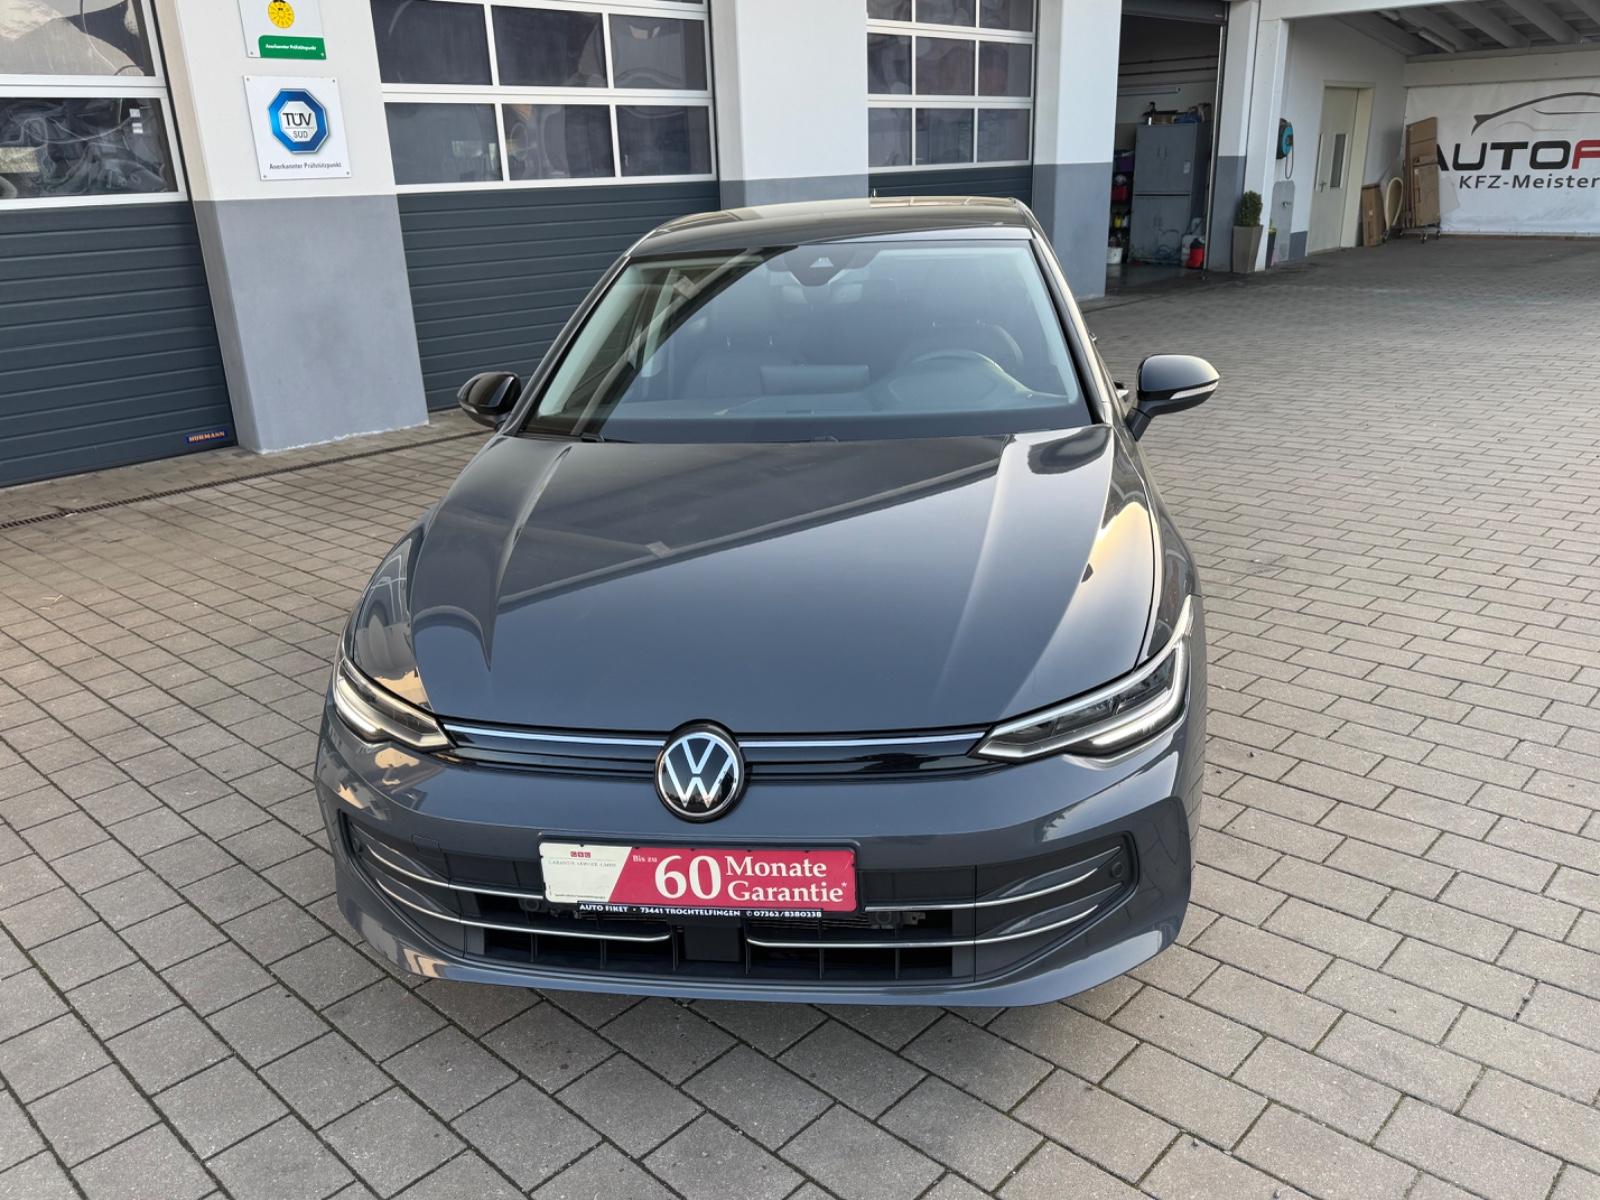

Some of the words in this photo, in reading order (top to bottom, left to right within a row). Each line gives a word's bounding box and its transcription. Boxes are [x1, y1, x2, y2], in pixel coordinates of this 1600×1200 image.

[282, 112, 312, 126] TÜV
[1459, 173, 1600, 189] KFZ-Meister
[632, 854, 646, 863] Bis
[725, 855, 827, 878] Monate
[655, 854, 722, 900] 60
[579, 904, 604, 912] AUTO
[665, 908, 741, 917] TROCHTELFINGEN
